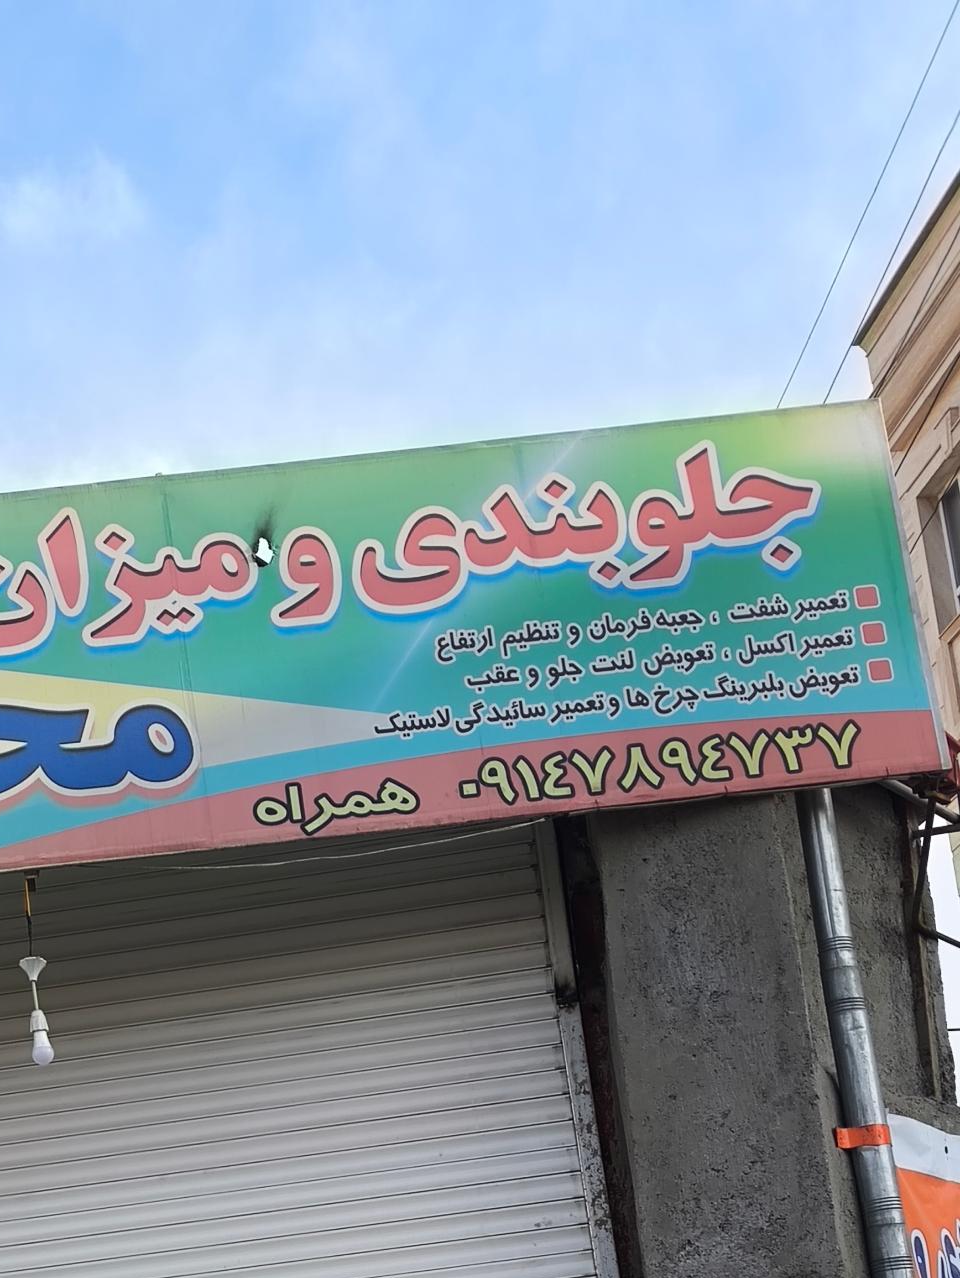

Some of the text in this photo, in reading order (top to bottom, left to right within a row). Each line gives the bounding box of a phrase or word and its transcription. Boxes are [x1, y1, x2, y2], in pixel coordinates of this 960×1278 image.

[354, 441, 820, 614] جلوبندی
[271, 526, 341, 627] و
[656, 609, 703, 632] جعبه
[794, 591, 848, 620] تعمیر
[503, 623, 559, 656] تنظیم
[590, 610, 651, 640] فرمان
[437, 628, 493, 661] ارتفاع
[800, 628, 853, 658] تعمیر
[548, 658, 582, 687] جلو
[592, 650, 634, 672] لنت
[644, 644, 713, 675] تعویض
[467, 665, 519, 691] عقب
[704, 674, 784, 702] بلبرینگ
[789, 666, 859, 697] تعویض
[374, 708, 450, 737] لاستیک
[254, 777, 419, 834] همراه
